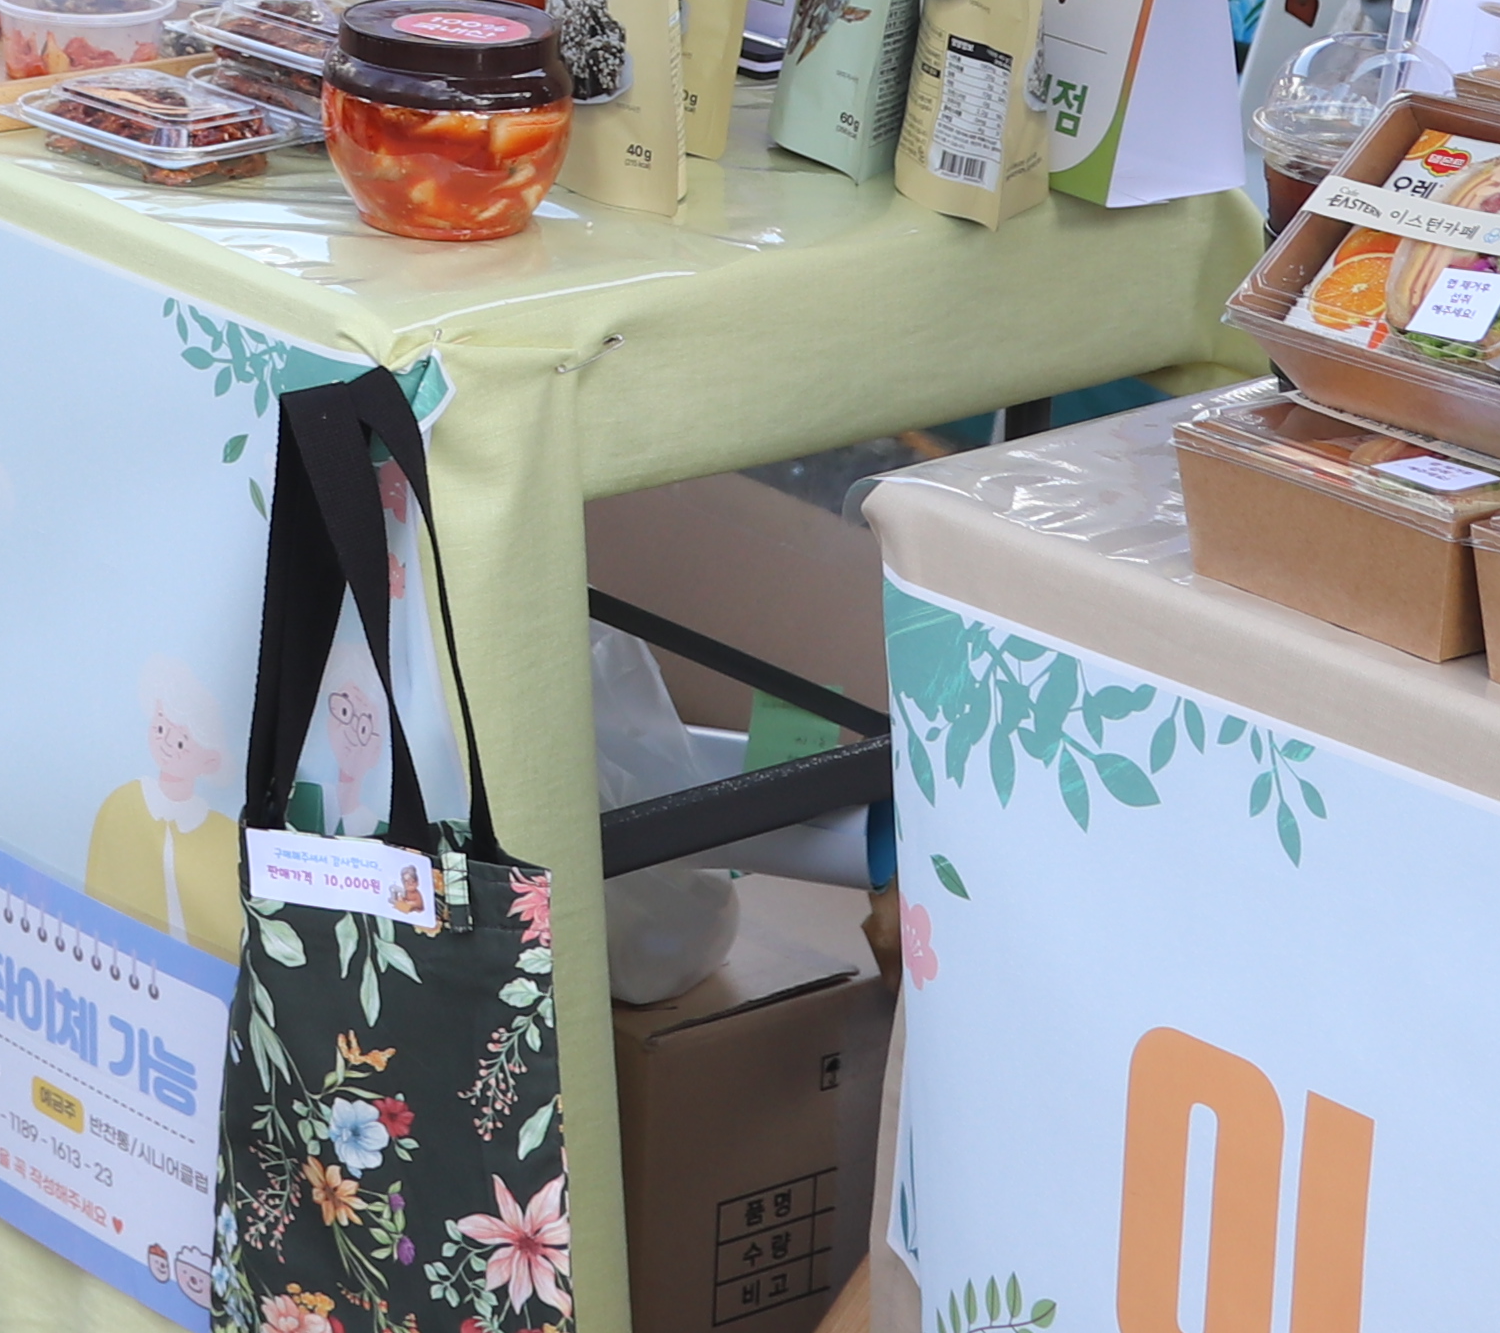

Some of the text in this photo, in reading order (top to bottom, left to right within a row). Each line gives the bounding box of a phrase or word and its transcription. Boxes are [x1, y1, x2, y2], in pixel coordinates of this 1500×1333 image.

[430, 15, 508, 33] 100%
[626, 143, 653, 162] 40g
[1325, 192, 1384, 220] EASTERN
[1389, 208, 1481, 241] 이스턴카페
[266, 864, 381, 896] 판매가격 10,000원
[108, 1013, 197, 1117] 가능
[39, 1085, 76, 1120] 예금주
[28, 1165, 109, 1229] 작성해주세요
[743, 1188, 792, 1227] 품명
[743, 1232, 791, 1267] 수량
[742, 1273, 789, 1305] 비고
